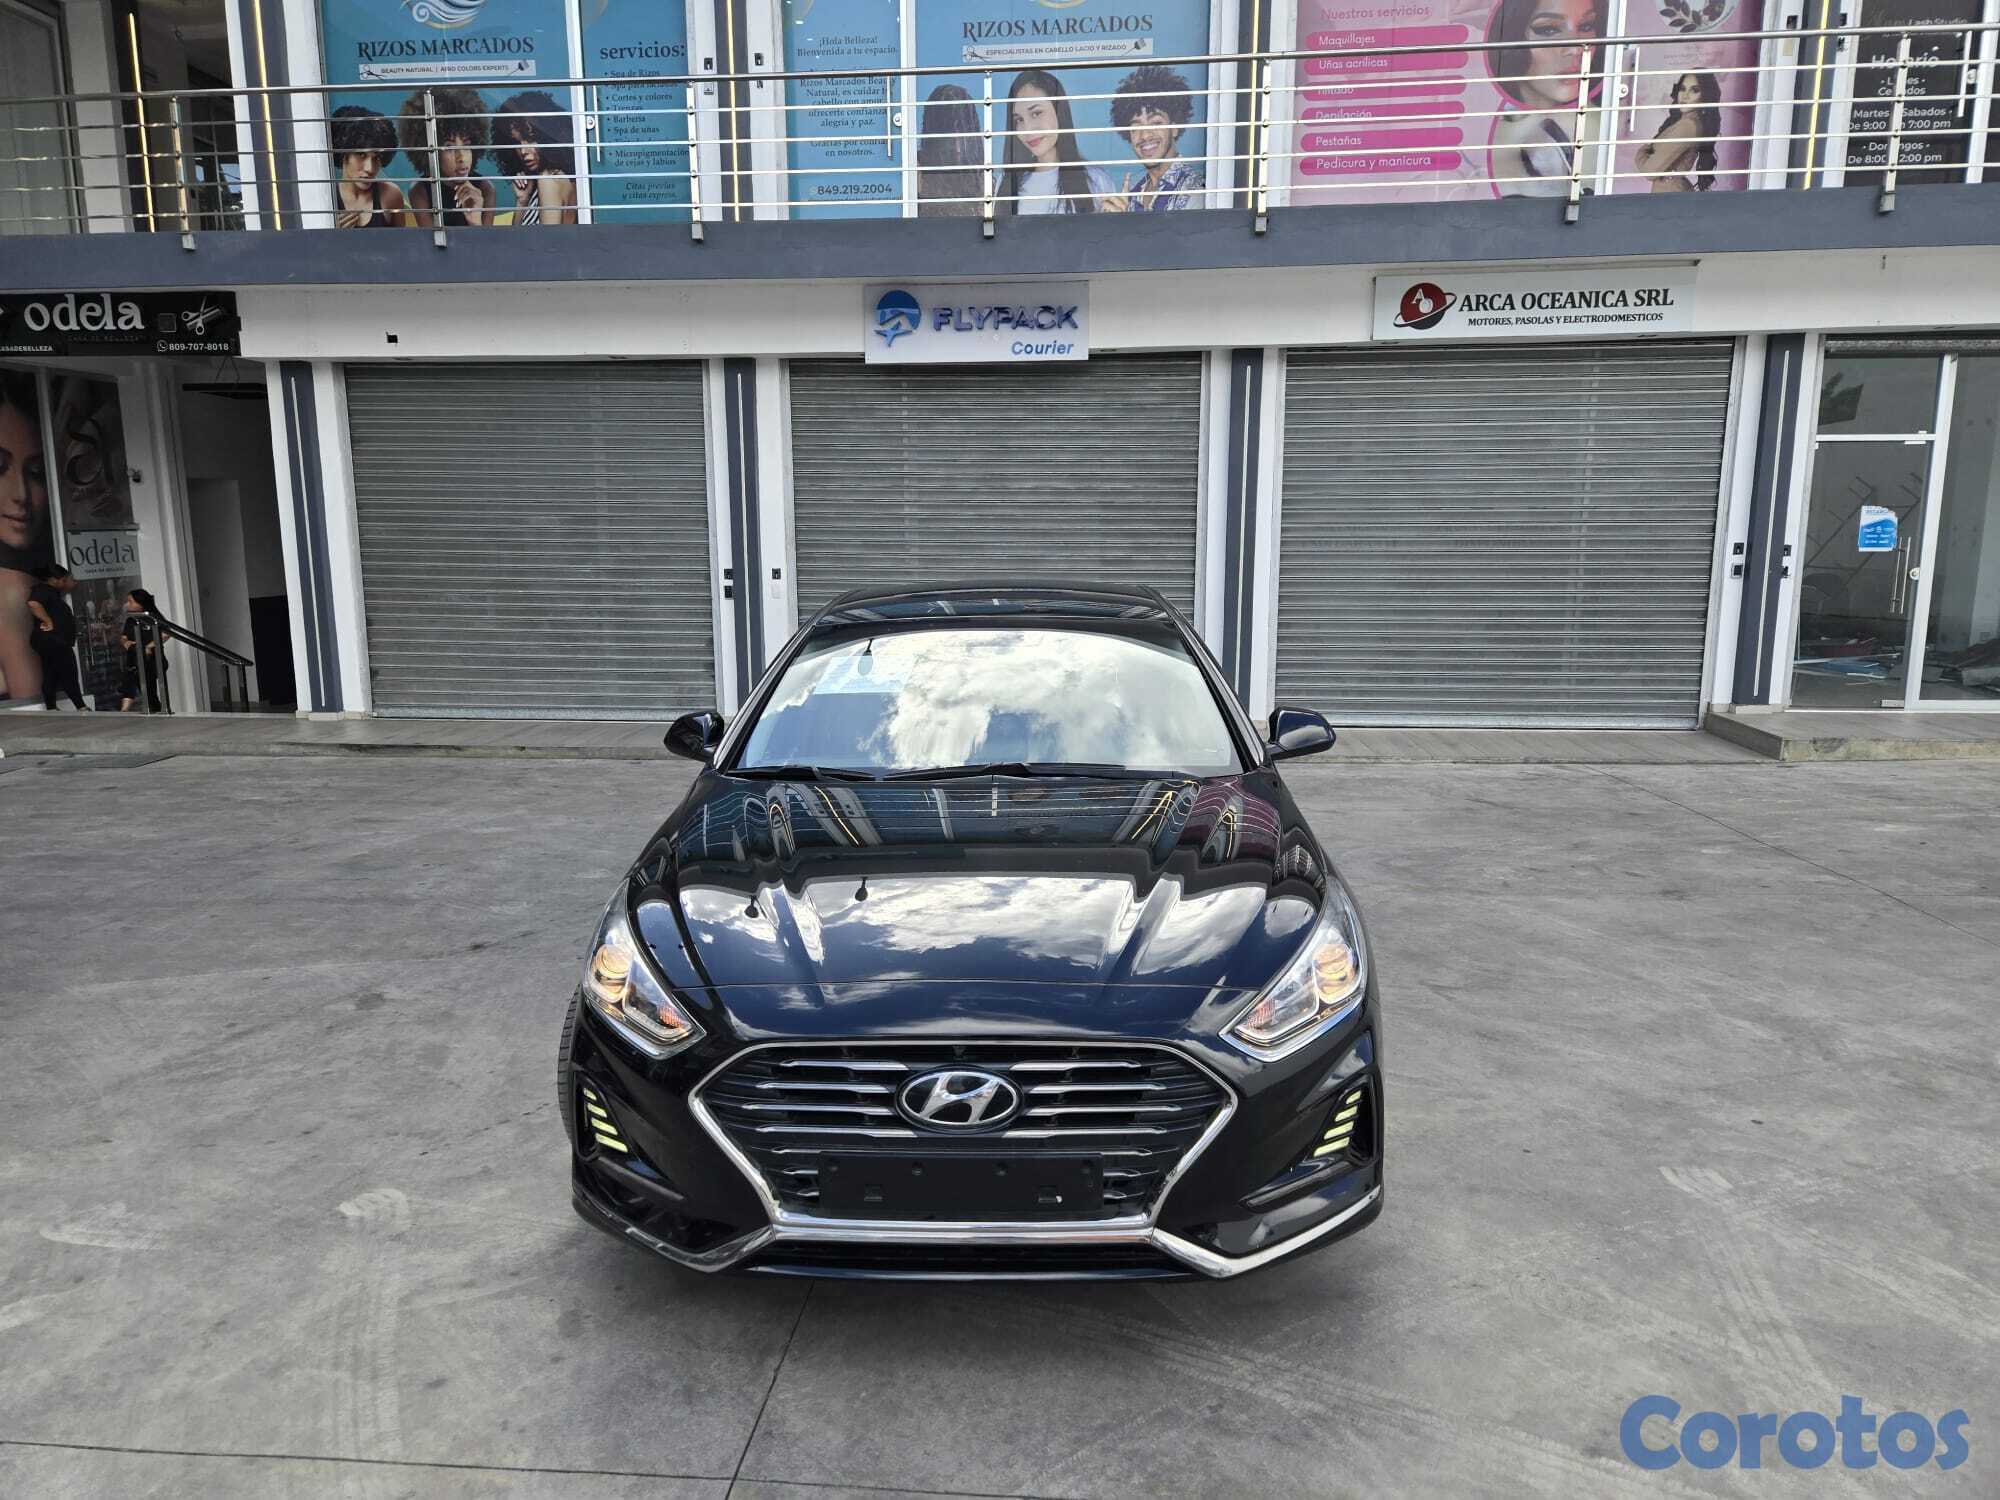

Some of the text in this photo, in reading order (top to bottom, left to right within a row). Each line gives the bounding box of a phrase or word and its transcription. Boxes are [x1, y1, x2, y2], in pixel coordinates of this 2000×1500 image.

[1321, 5, 1432, 20] Nuestros servicios
[963, 15, 1153, 43] RIZOS MARCADOS
[1319, 33, 1376, 47] Maquillajes
[357, 37, 534, 61] RIZOS MARCADOS
[600, 41, 684, 59] servicios:
[797, 48, 845, 57] Bienvenida
[985, 47, 1034, 56] ESPECIALISTAS
[1319, 59, 1343, 70] Uñas
[1853, 109, 1890, 118] Martes
[1863, 120, 1887, 130] 9:00
[1908, 119, 1931, 129] 7:00
[1933, 120, 1951, 130] pm
[1315, 134, 1363, 147] Pestañas
[1316, 154, 1432, 170] Pedicura y manicura
[1848, 155, 1863, 164] De
[1924, 153, 1942, 163] pm
[817, 183, 893, 196] 849.219.2004
[1458, 288, 1674, 312] ARCA OCEANICA SRL
[24, 293, 144, 332] odela
[932, 305, 1079, 332] FLYPACK
[1468, 312, 1664, 326] MOTORES, PASOLAS Y ELECTRODOMESTICOS
[169, 343, 229, 351] 809-707-8018
[1011, 340, 1074, 356] Courier
[70, 539, 136, 566] odela
